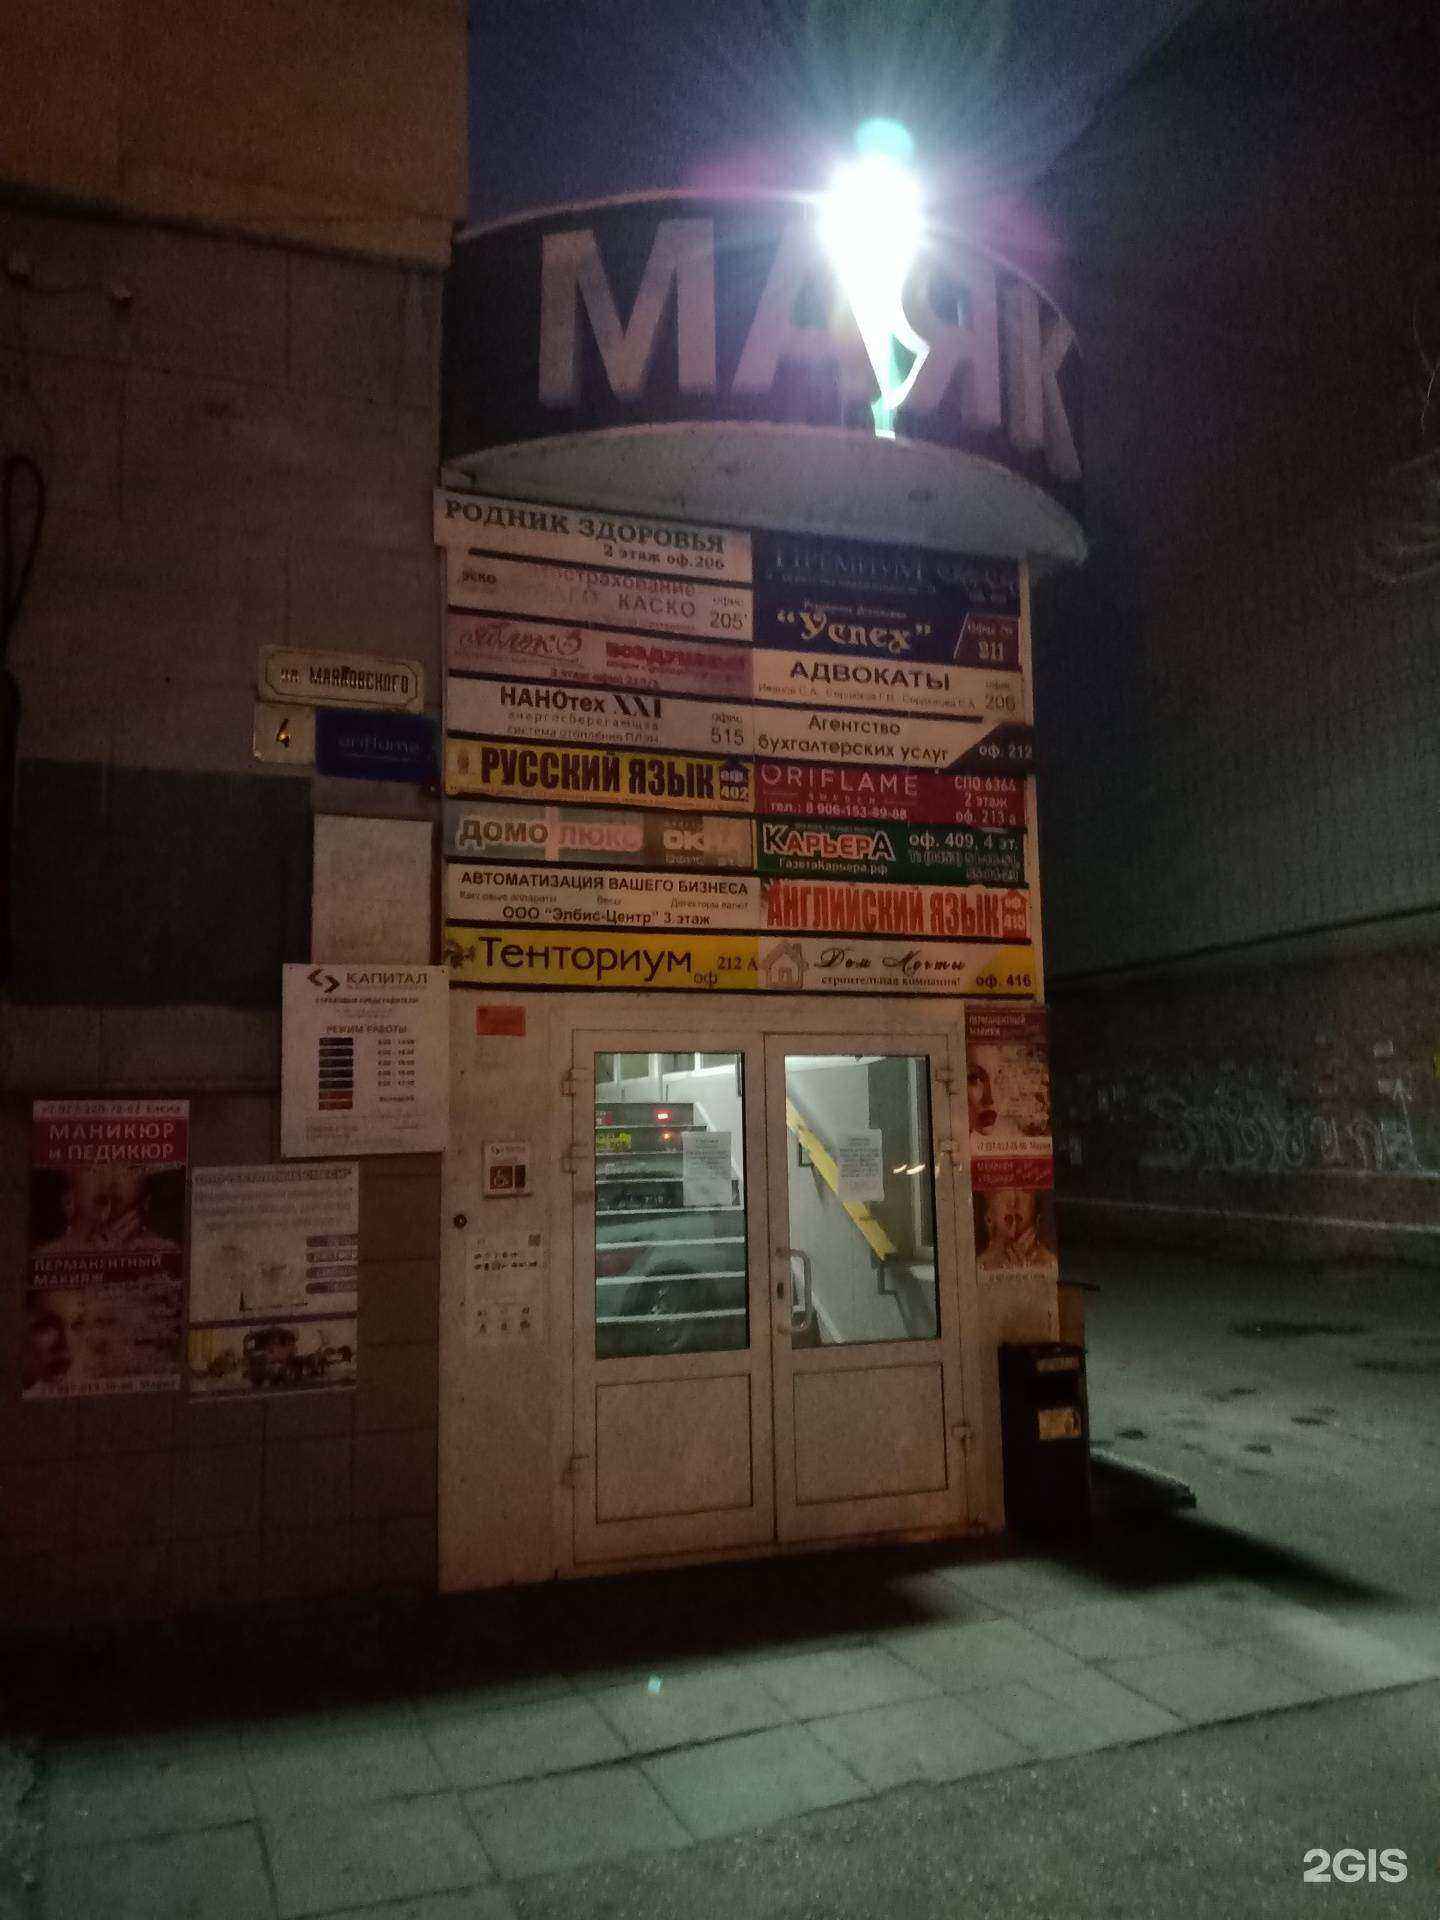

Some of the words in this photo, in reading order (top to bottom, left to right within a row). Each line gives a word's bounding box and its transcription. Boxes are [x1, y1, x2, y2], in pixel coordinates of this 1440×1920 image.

[539, 215, 1086, 481] МАЯК
[445, 499, 570, 536] РОДНИК
[578, 518, 726, 554] ЗДОРОВЬЯ
[617, 593, 696, 618] КАСКО
[308, 666, 410, 694] МАЯКОВСКОГО
[789, 660, 950, 691] АДВОКАТЫ
[710, 727, 744, 746] 515
[807, 714, 902, 737] Агентство
[757, 732, 896, 759] бухгалтерских
[480, 746, 621, 793] РУССКИЙ
[628, 756, 715, 799] ЯЗЫК
[760, 764, 919, 797] ORIFLAME
[458, 816, 550, 853] ДОМО
[460, 872, 604, 892] АВТОМАТИЗАЦИЯ
[608, 878, 674, 893] ВАШЕГО
[678, 881, 749, 896] БИЗНЕСА
[502, 905, 540, 921] ООО
[676, 913, 711, 926] этаж
[766, 884, 926, 934] АНГЛИЙСКИЙ
[929, 891, 999, 935] ЯЗЫК
[478, 936, 692, 982] Тенториум
[345, 971, 429, 985] КАПИТАЛ
[48, 1122, 177, 1141] МАНИКЮР
[67, 1142, 175, 1164] ПЕДИКЮР
